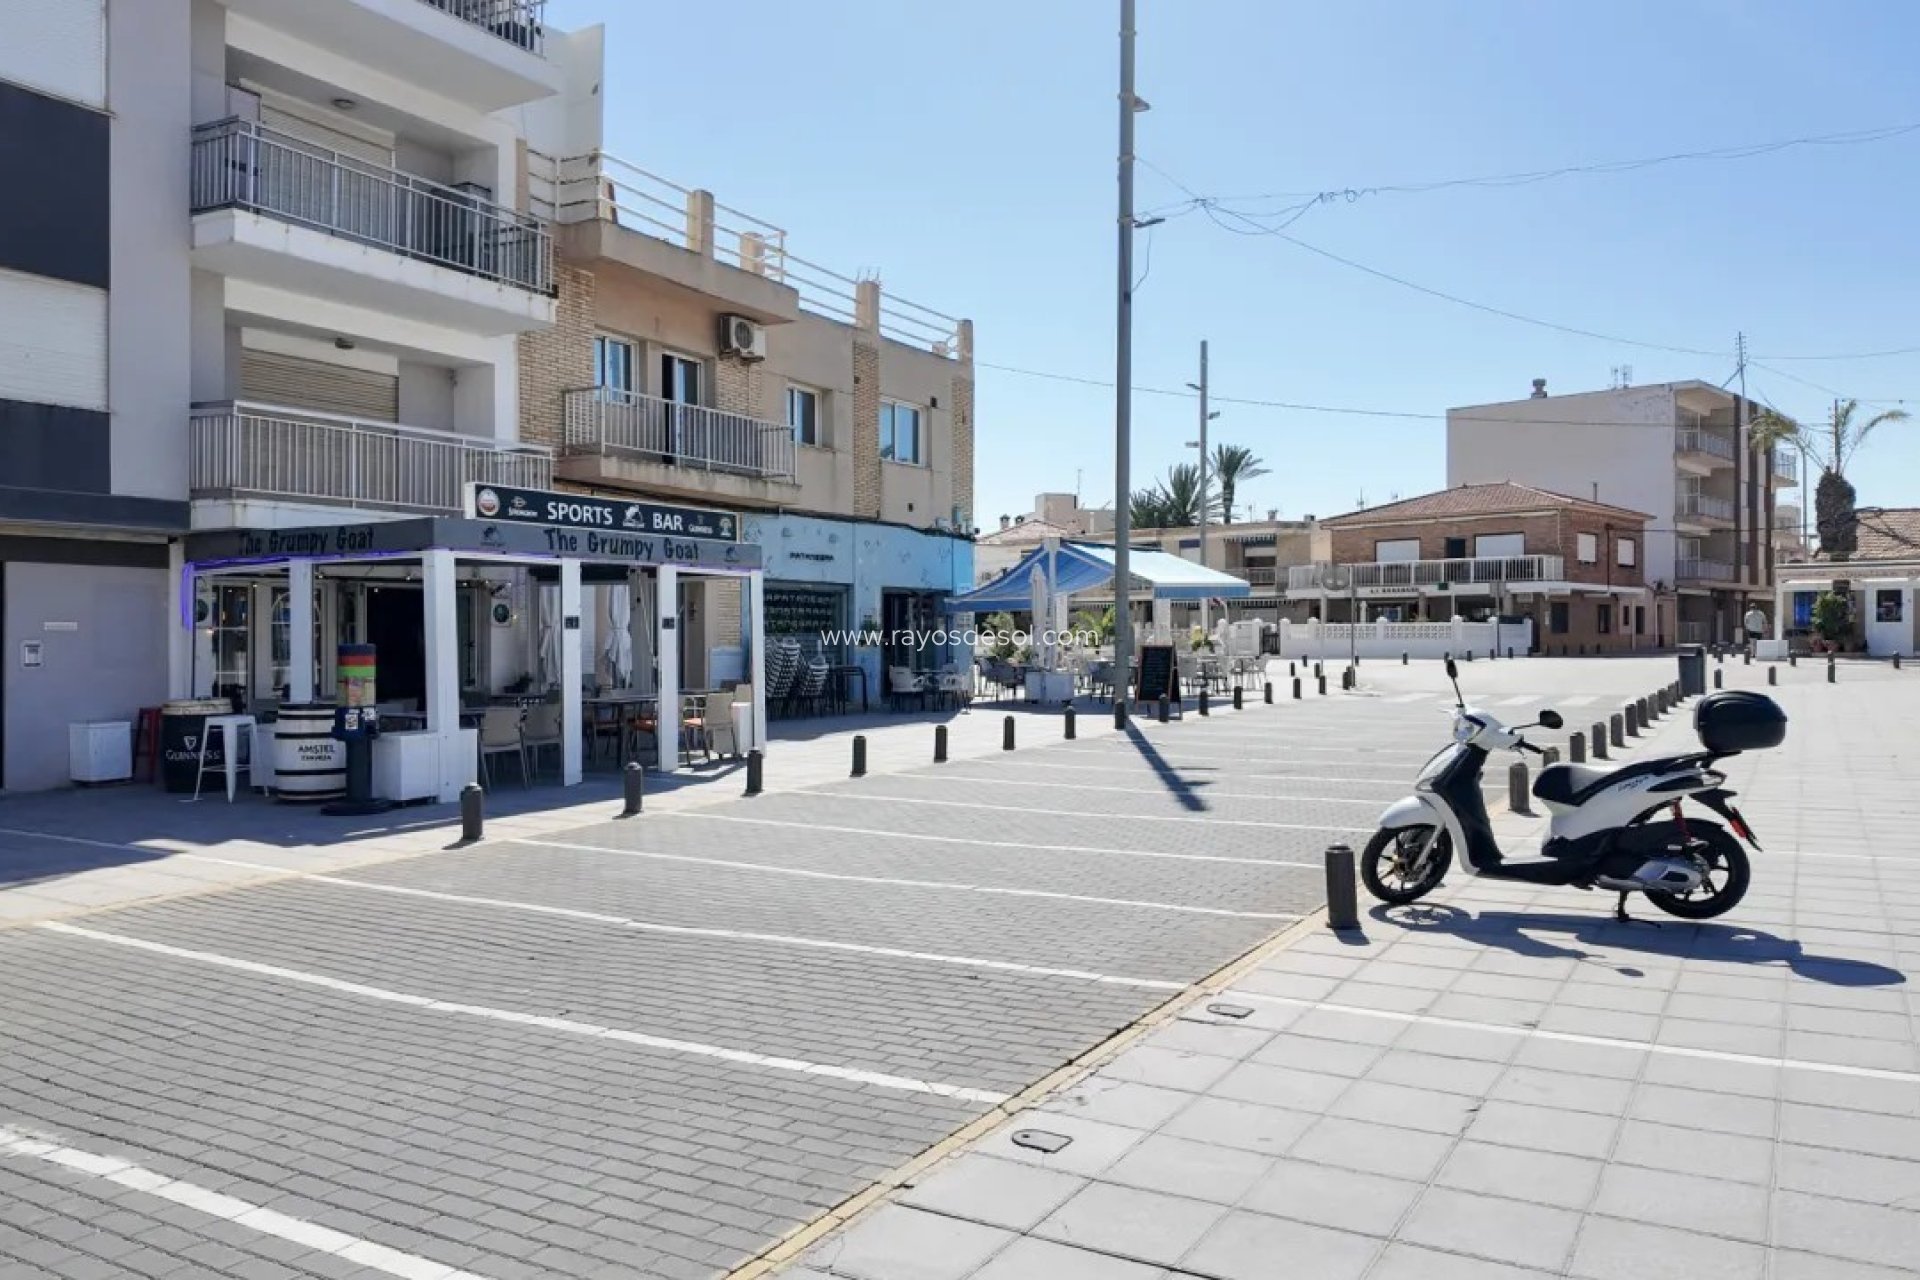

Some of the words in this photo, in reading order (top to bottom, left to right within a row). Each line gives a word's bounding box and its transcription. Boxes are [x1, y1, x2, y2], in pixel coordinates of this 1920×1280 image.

[547, 501, 613, 525] SPORTS
[653, 512, 684, 531] BAR
[239, 532, 261, 556] The
[269, 531, 328, 555] Grumpy
[336, 527, 374, 550] Goat
[543, 529, 577, 552] The
[588, 531, 653, 560] Grumpy
[664, 538, 699, 560] Goat
[298, 744, 335, 754] AMSTEL
